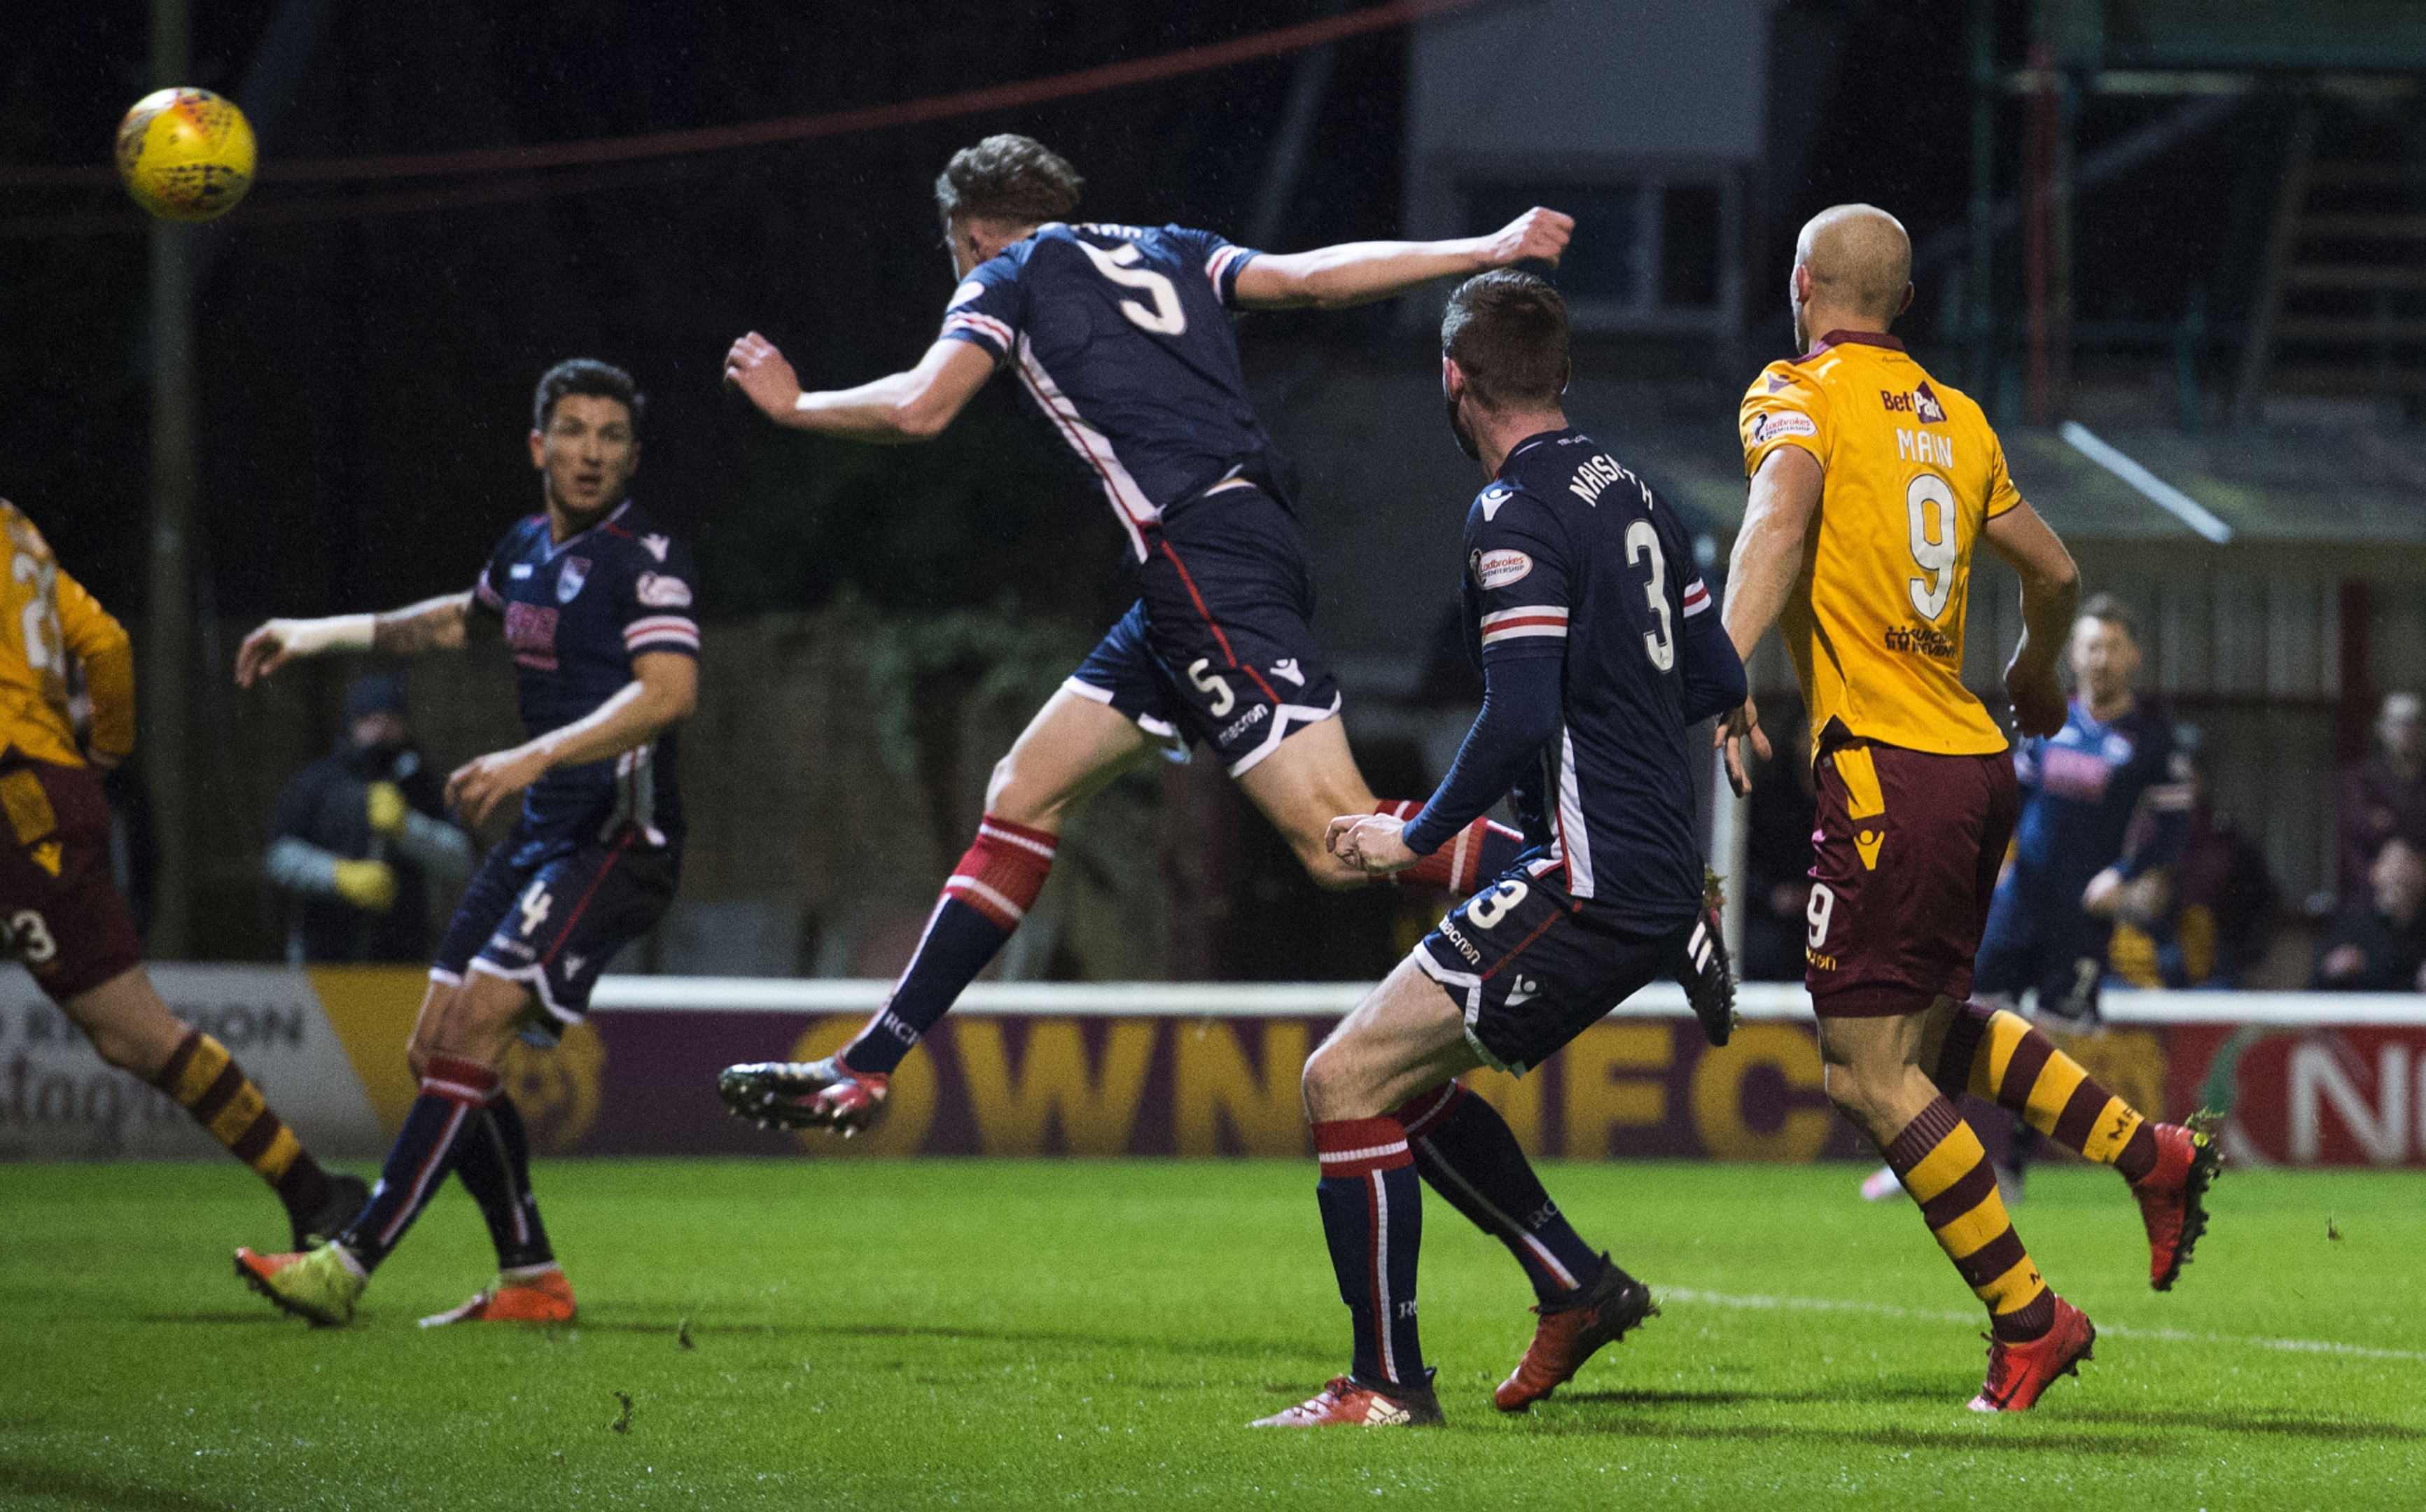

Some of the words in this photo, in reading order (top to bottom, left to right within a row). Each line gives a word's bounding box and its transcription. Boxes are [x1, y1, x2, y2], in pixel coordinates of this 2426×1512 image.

[1076, 241, 1186, 335] 5
[1880, 390, 1912, 412] Bet
[1896, 428, 1953, 469] MAIN
[1906, 473, 1957, 621] 9
[1624, 518, 1674, 673] 3
[1188, 657, 1235, 718] 5
[520, 878, 554, 936] 4
[1468, 879, 1528, 929] 3
[1806, 883, 1834, 948] 9
[791, 1013, 1308, 1158] OWN
